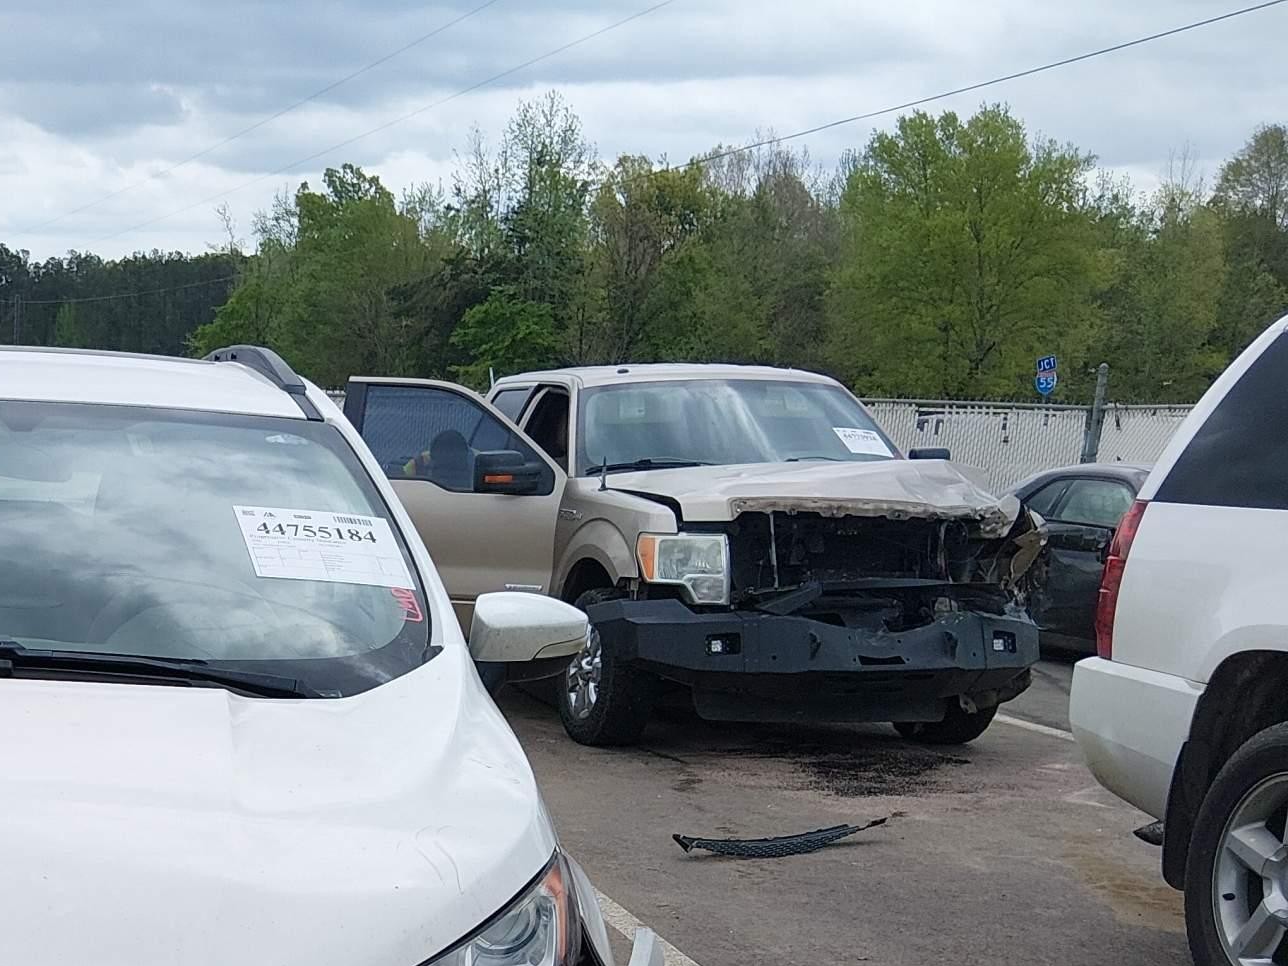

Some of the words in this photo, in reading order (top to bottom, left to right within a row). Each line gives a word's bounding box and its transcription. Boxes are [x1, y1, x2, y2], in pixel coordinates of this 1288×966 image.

[1039, 357, 1055, 371] JCT
[1039, 377, 1054, 388] 55
[256, 522, 377, 543] 44755184
